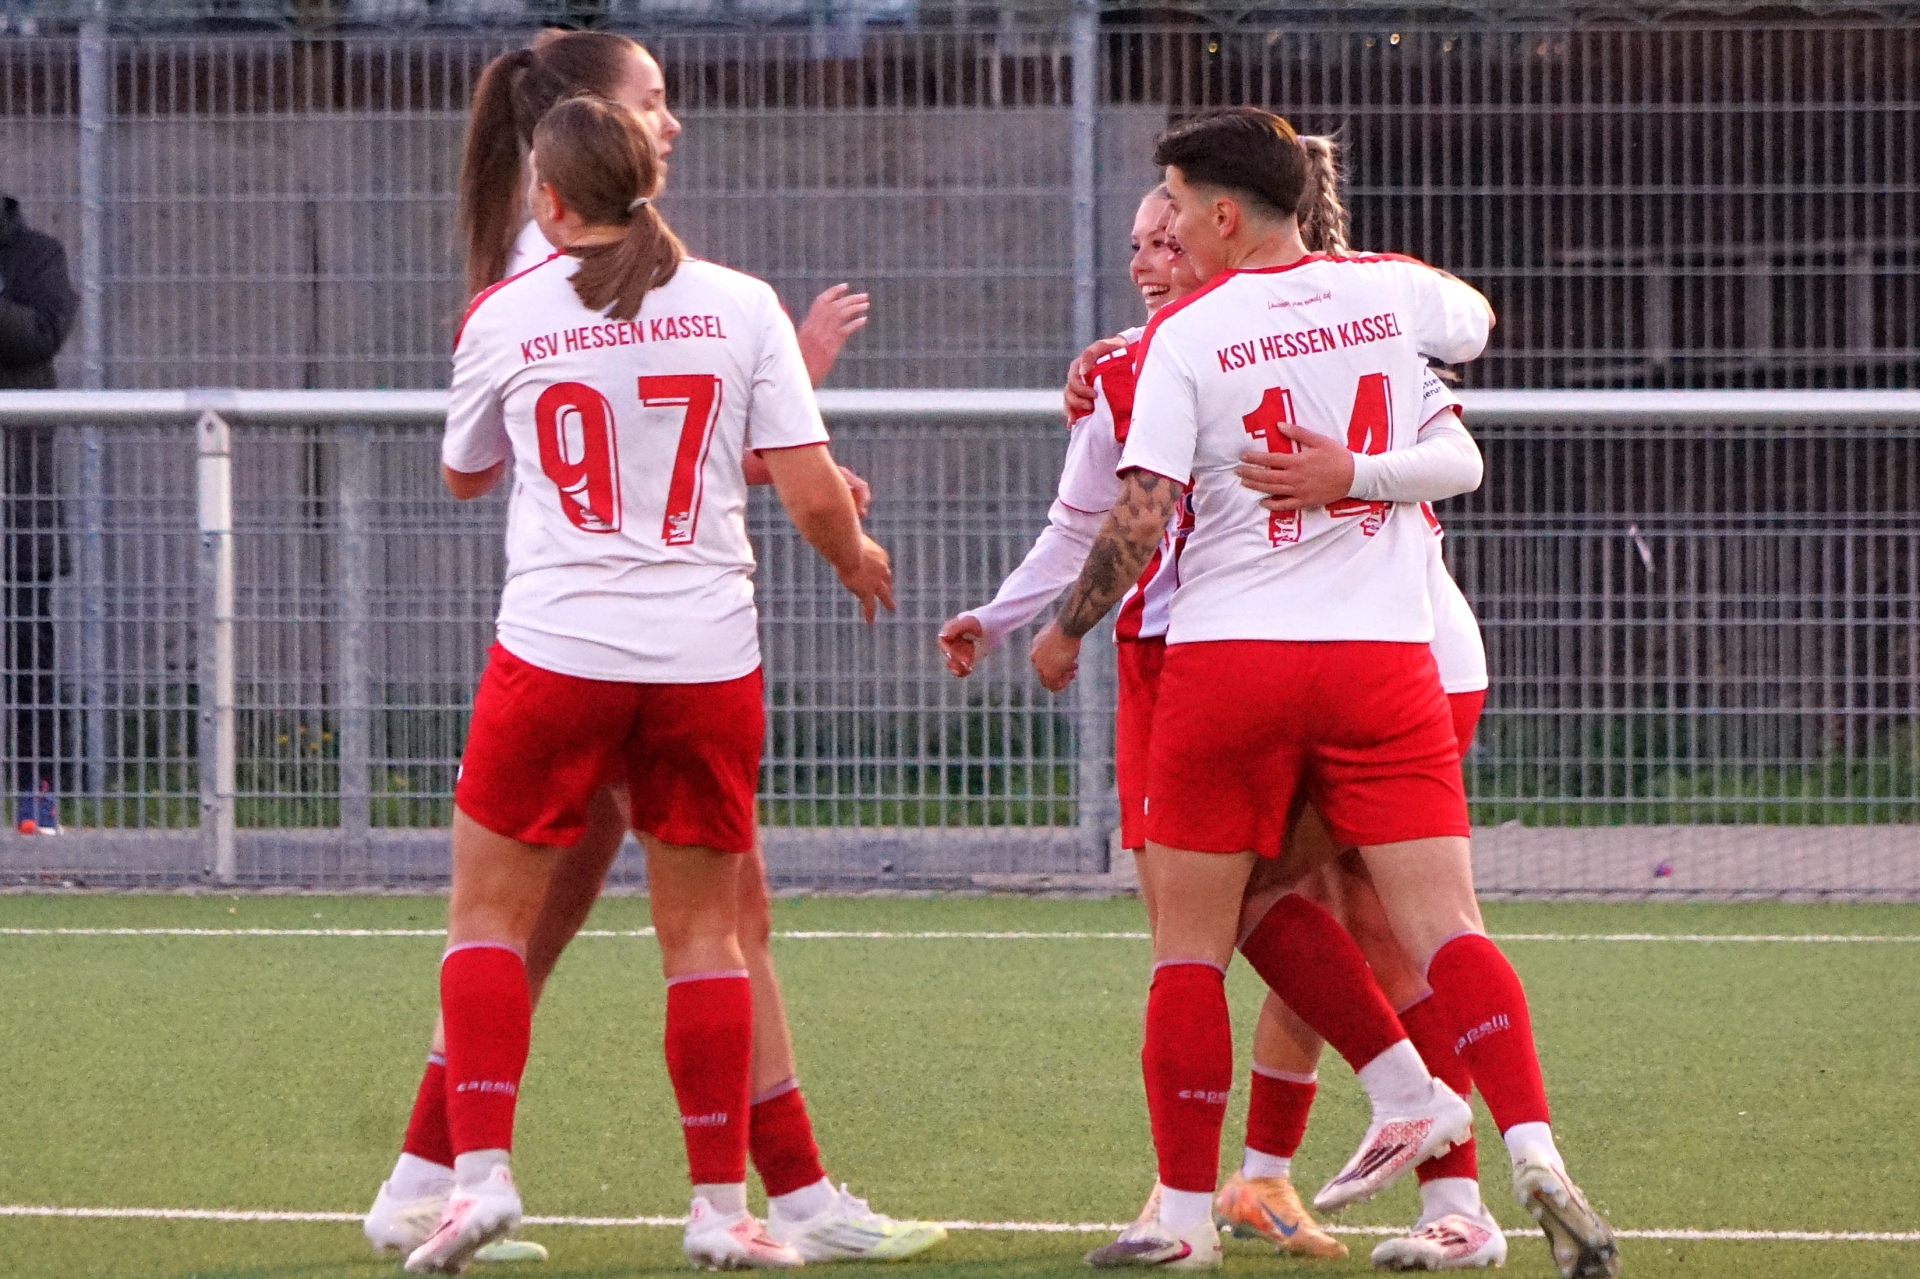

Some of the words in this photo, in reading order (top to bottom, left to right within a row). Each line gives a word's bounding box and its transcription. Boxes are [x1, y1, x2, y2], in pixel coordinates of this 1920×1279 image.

[520, 332, 559, 364] KSV
[564, 320, 645, 352] HESSEN
[650, 315, 727, 342] KASSEL
[1216, 340, 1257, 373] KSV
[1259, 327, 1337, 361] HESSEN
[1337, 312, 1403, 348] KASSEL
[535, 374, 723, 546] 97
[1241, 371, 1394, 548] 14
